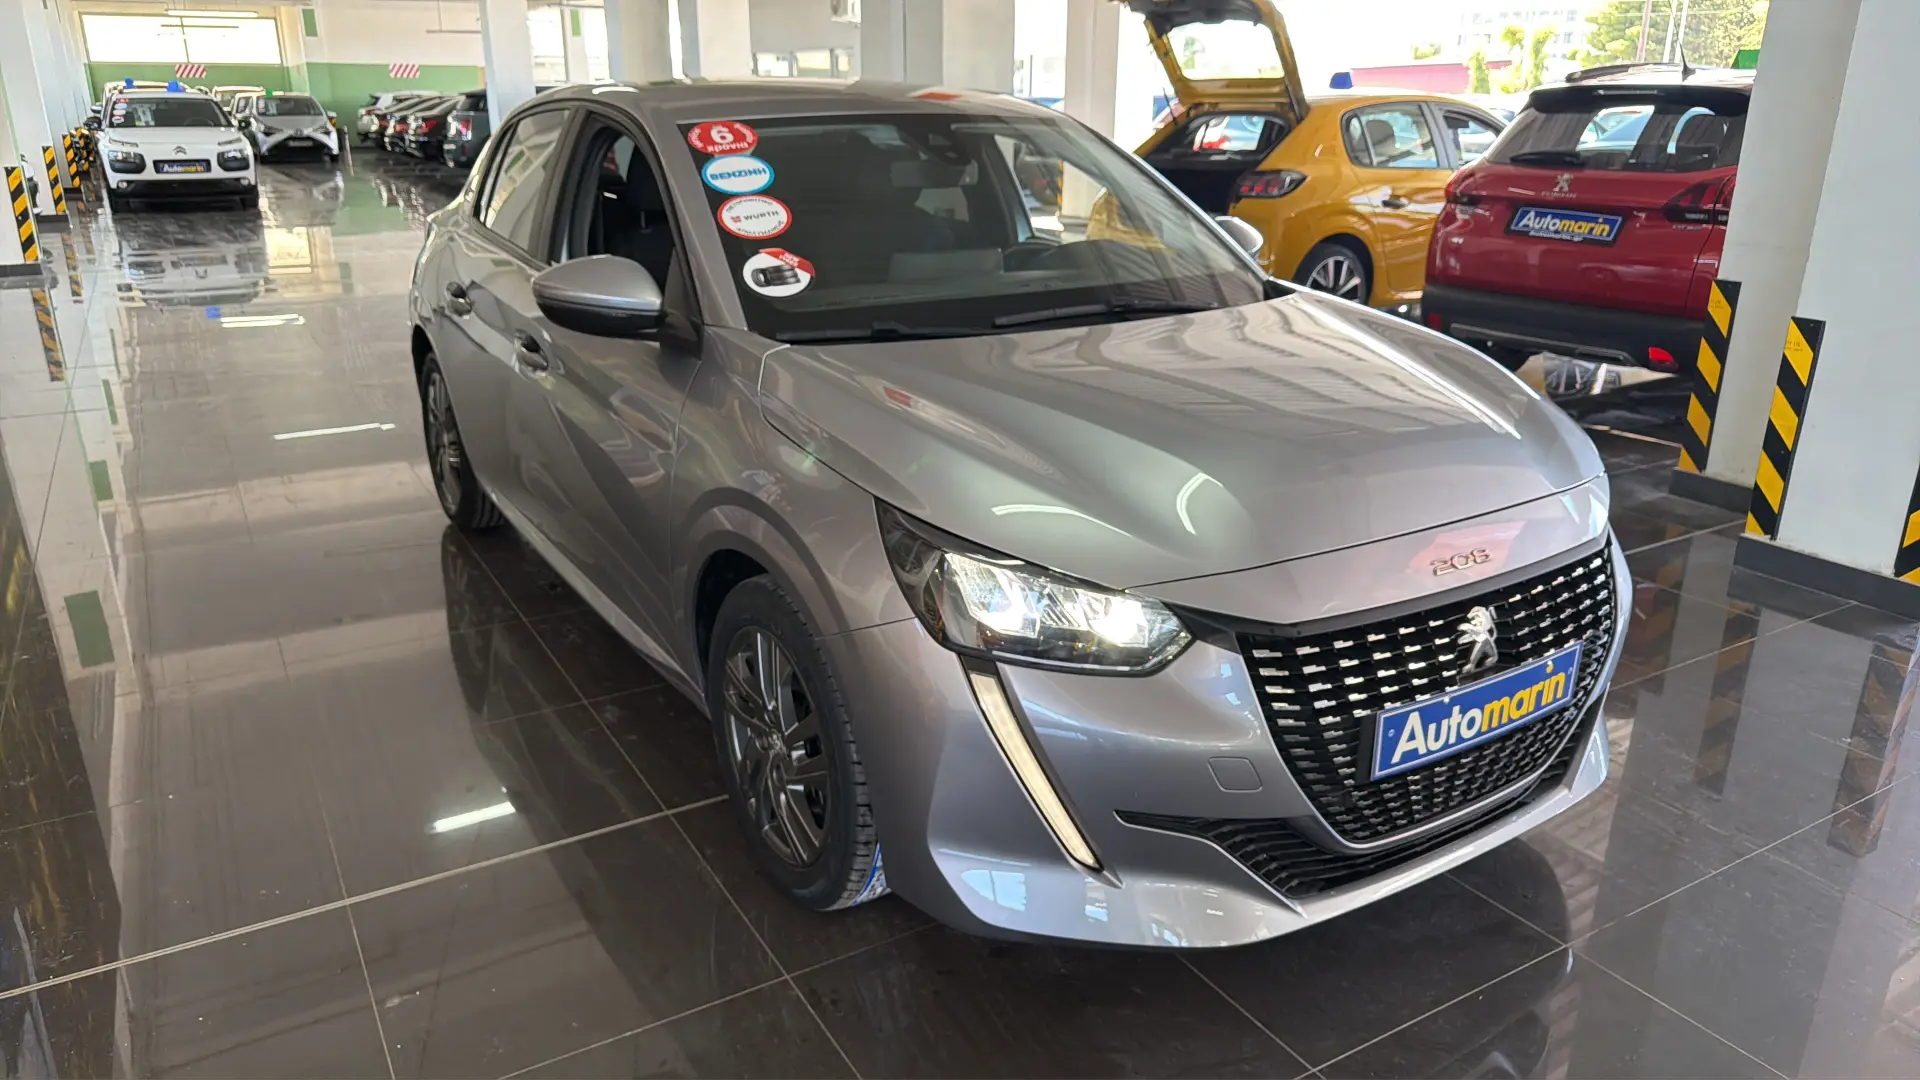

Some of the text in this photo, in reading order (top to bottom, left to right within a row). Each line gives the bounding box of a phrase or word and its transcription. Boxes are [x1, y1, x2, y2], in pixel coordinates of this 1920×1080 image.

[710, 125, 734, 144] 6
[1518, 210, 1611, 238] Automarin
[1429, 547, 1492, 577] 208
[1390, 661, 1567, 765] Automarin
